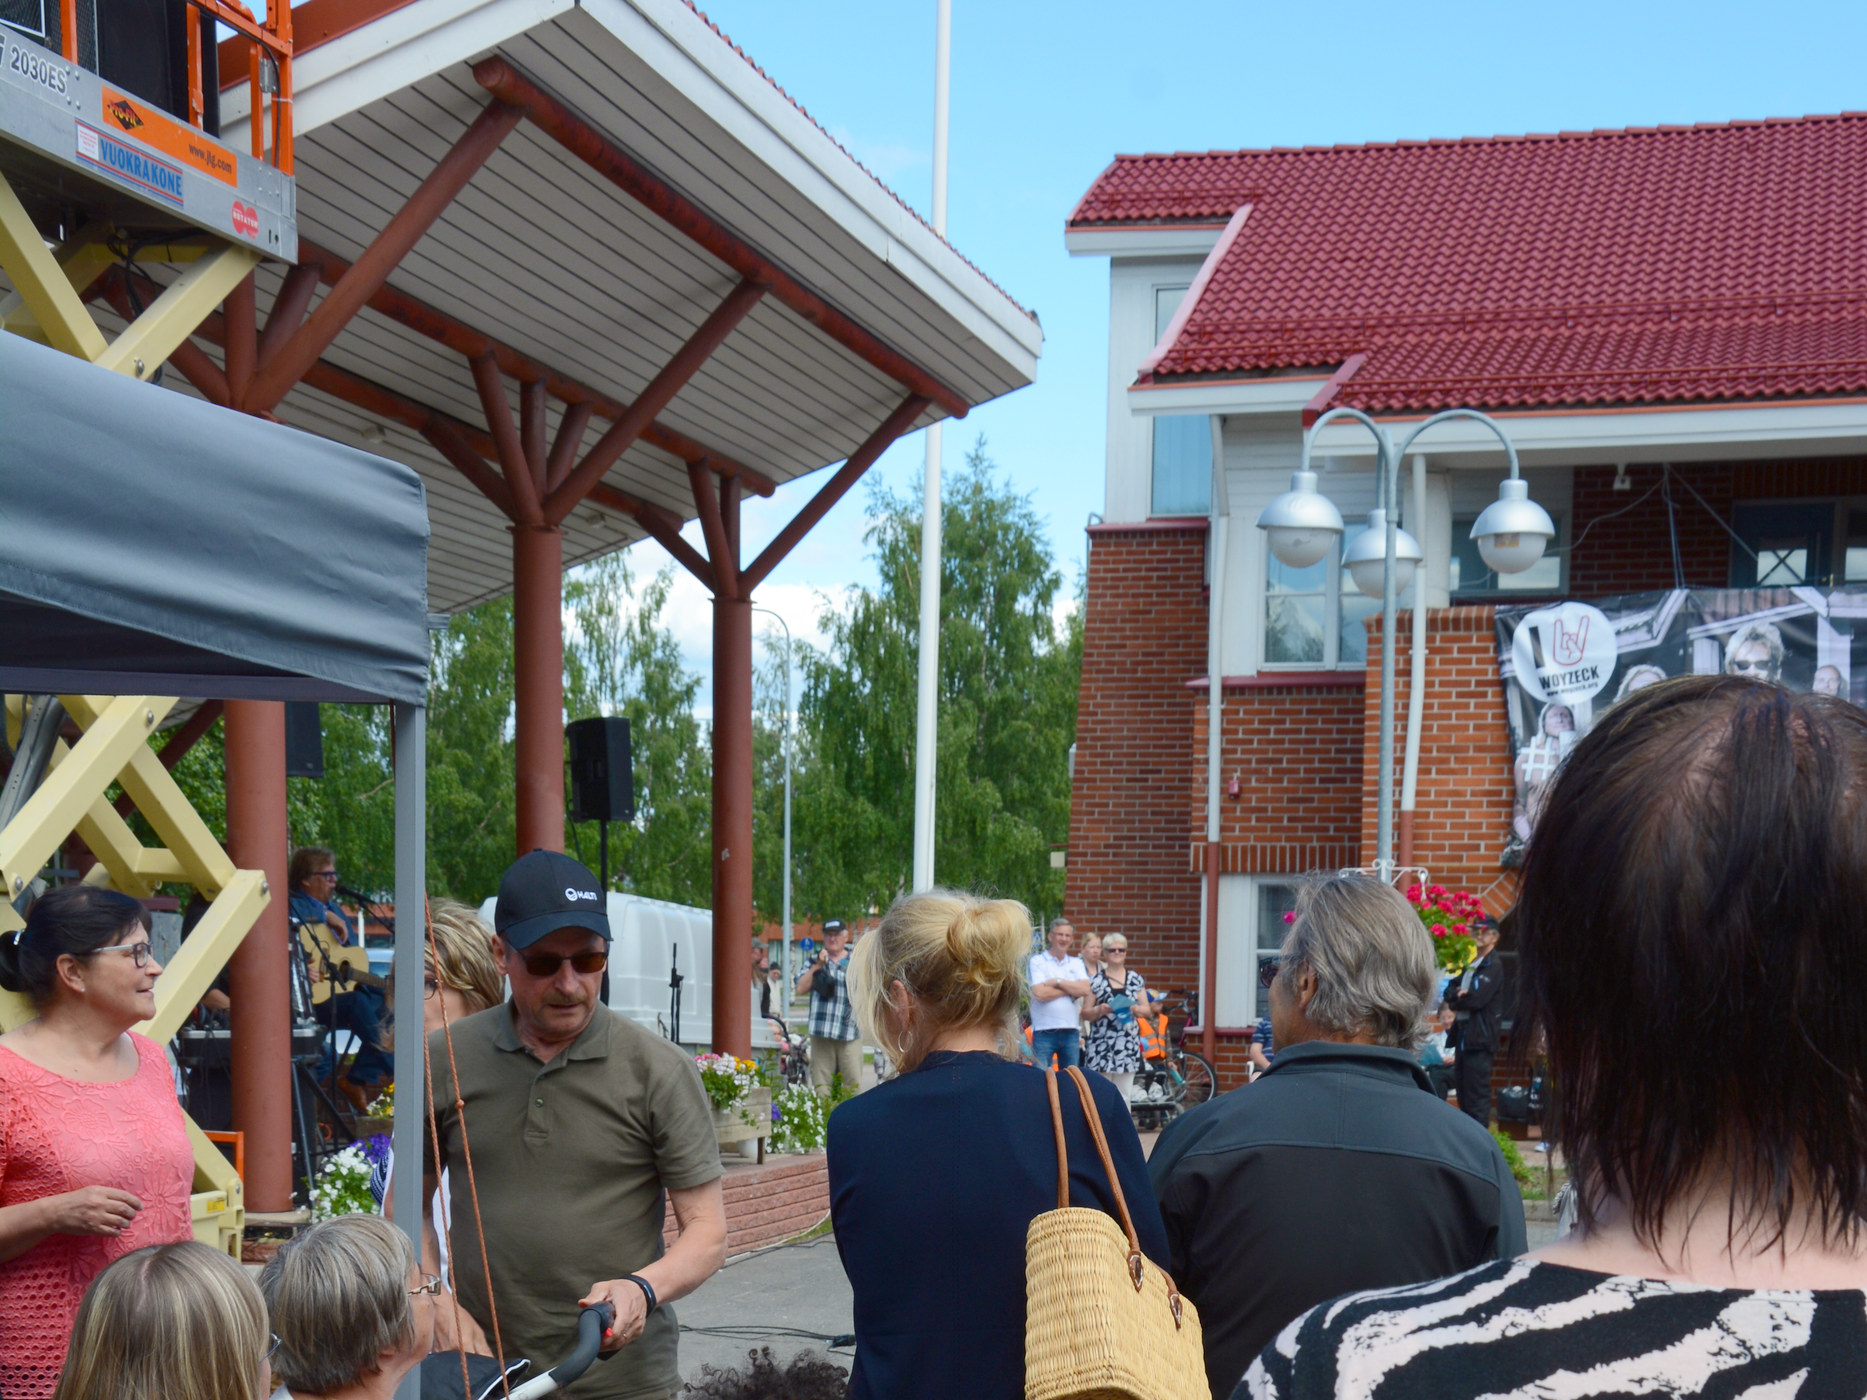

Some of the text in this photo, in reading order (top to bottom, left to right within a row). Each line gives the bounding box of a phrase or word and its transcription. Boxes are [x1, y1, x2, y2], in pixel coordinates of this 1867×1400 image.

[10, 45, 67, 95] 2030ES
[100, 138, 183, 196] VUOKRAKONE
[188, 143, 232, 174] www.jlg.com
[1539, 665, 1600, 690] WOYZECK
